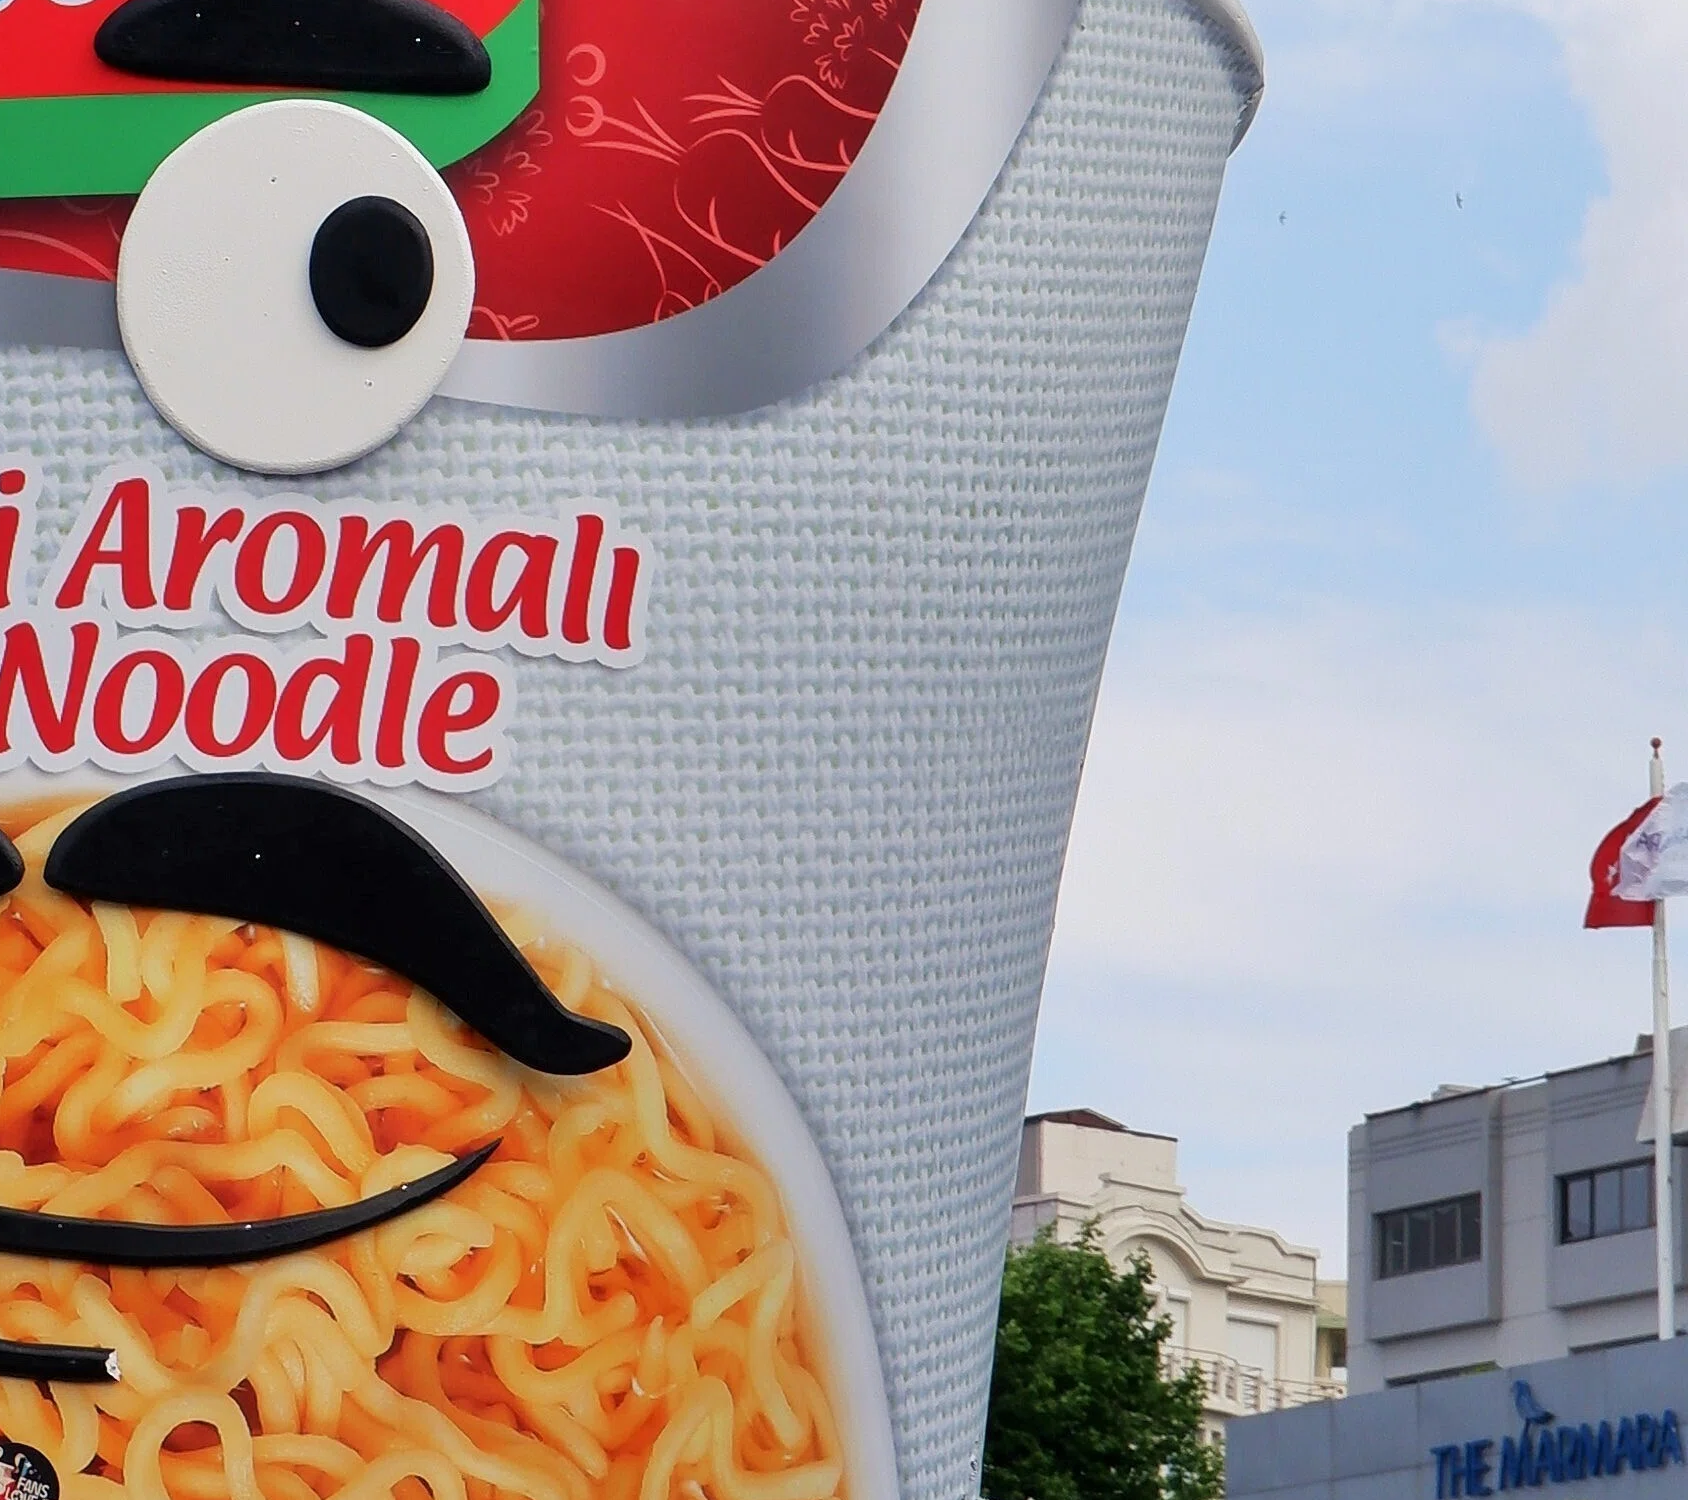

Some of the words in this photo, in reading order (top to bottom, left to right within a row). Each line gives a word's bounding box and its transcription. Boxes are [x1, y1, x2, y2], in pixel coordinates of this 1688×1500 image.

[56, 478, 641, 652] Aromalı
[16, 1476, 50, 1499] FANS
[1430, 1439, 1494, 1500] THE
[1498, 1409, 1686, 1491] MARMARA
